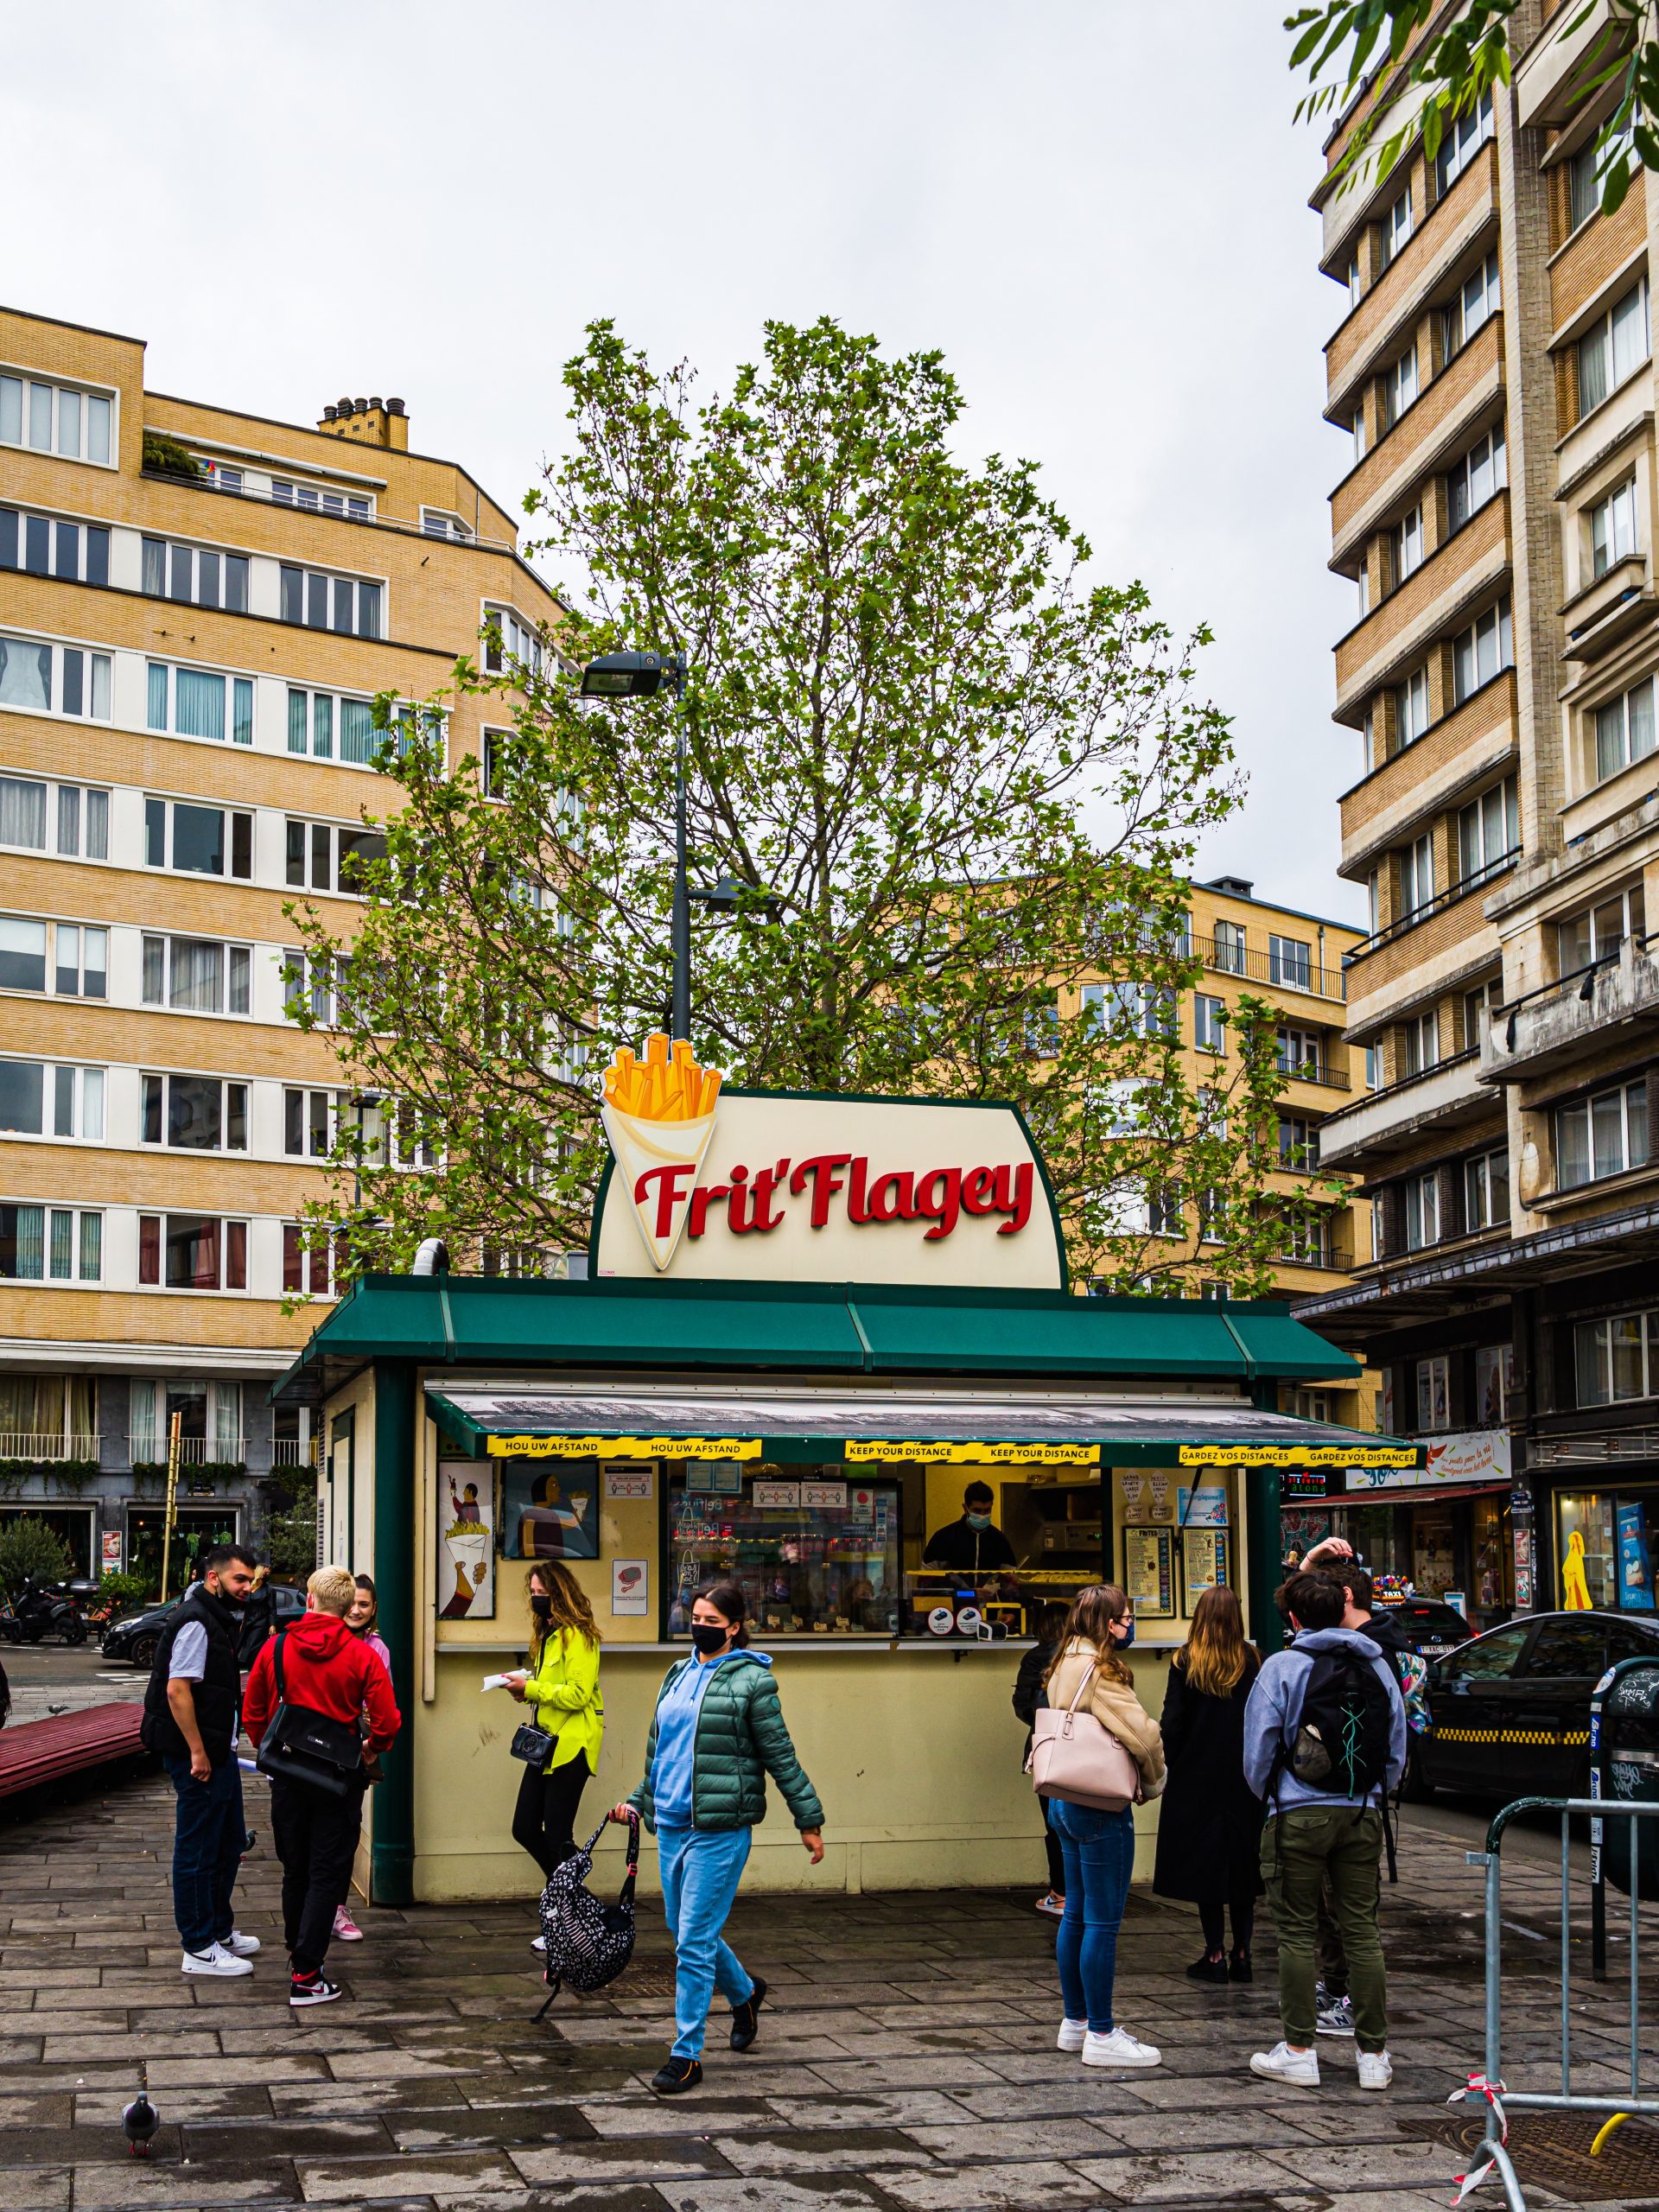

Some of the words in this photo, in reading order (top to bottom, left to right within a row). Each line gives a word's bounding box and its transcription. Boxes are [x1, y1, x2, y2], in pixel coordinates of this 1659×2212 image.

[634, 1153, 1034, 1241] Frit'Flagey
[505, 1442, 529, 1451] HOU
[531, 1442, 549, 1451] UW
[550, 1443, 598, 1452] AFSTAND
[651, 1444, 674, 1452] HOU
[695, 1445, 741, 1453] AFSTAND
[849, 1446, 874, 1455] KEEP
[876, 1447, 904, 1456] YOUR
[906, 1447, 952, 1457] DISTANCE
[990, 1449, 1015, 1458] KEEP
[1017, 1449, 1043, 1459] YOUR
[1045, 1450, 1090, 1459] DISTANCE
[1181, 1452, 1217, 1460] GARDEZ
[1220, 1452, 1238, 1460] VOS
[1240, 1452, 1289, 1461] DISTANCES
[1310, 1452, 1345, 1461] GARDEZ
[1367, 1453, 1414, 1462] DISTANCES
[1182, 1492, 1224, 1502] Allrgiques?
[1591, 1770, 1599, 1800] Bruno
